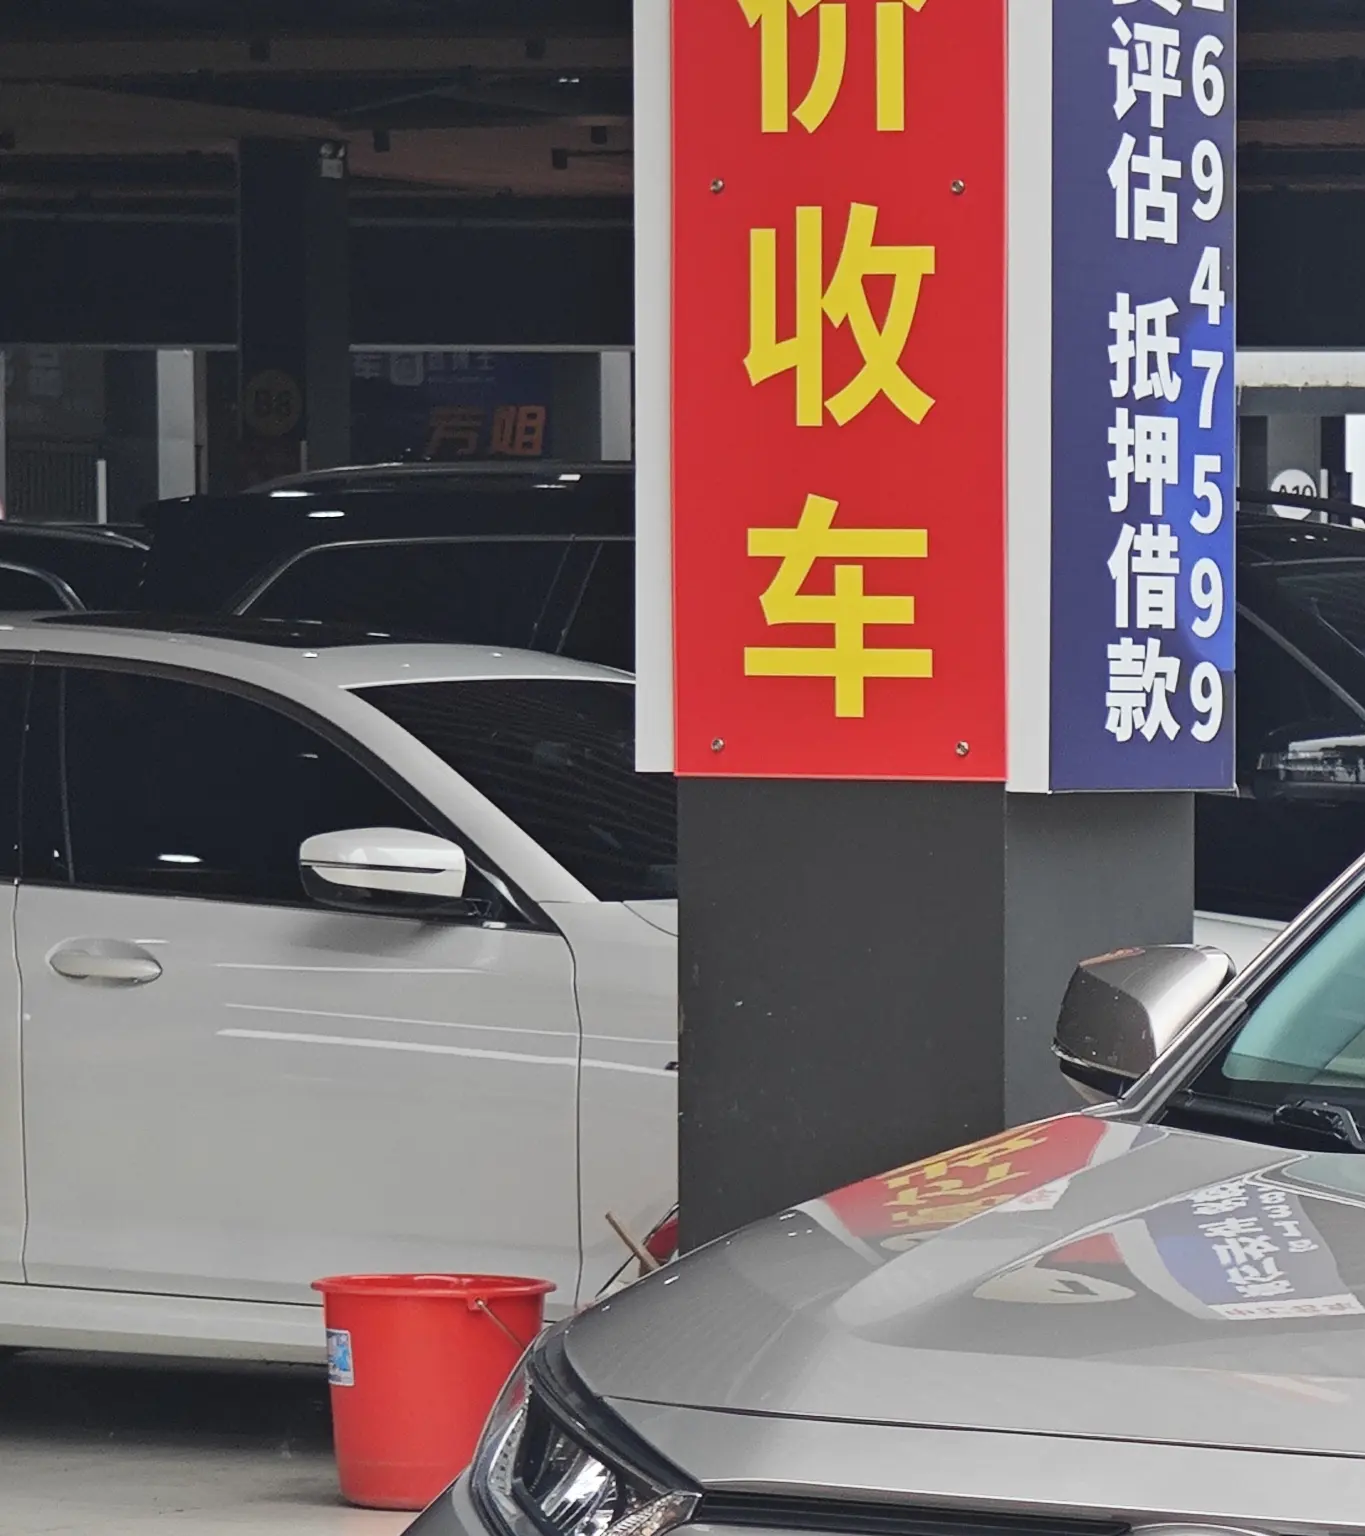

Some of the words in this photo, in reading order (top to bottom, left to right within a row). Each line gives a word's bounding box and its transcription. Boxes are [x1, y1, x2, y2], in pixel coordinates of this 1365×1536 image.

[742, 0, 935, 717] 价收车
[1107, 0, 1182, 244] 评估
[1187, 0, 1225, 743] 6947599
[1105, 292, 1182, 743] 抵押借款
